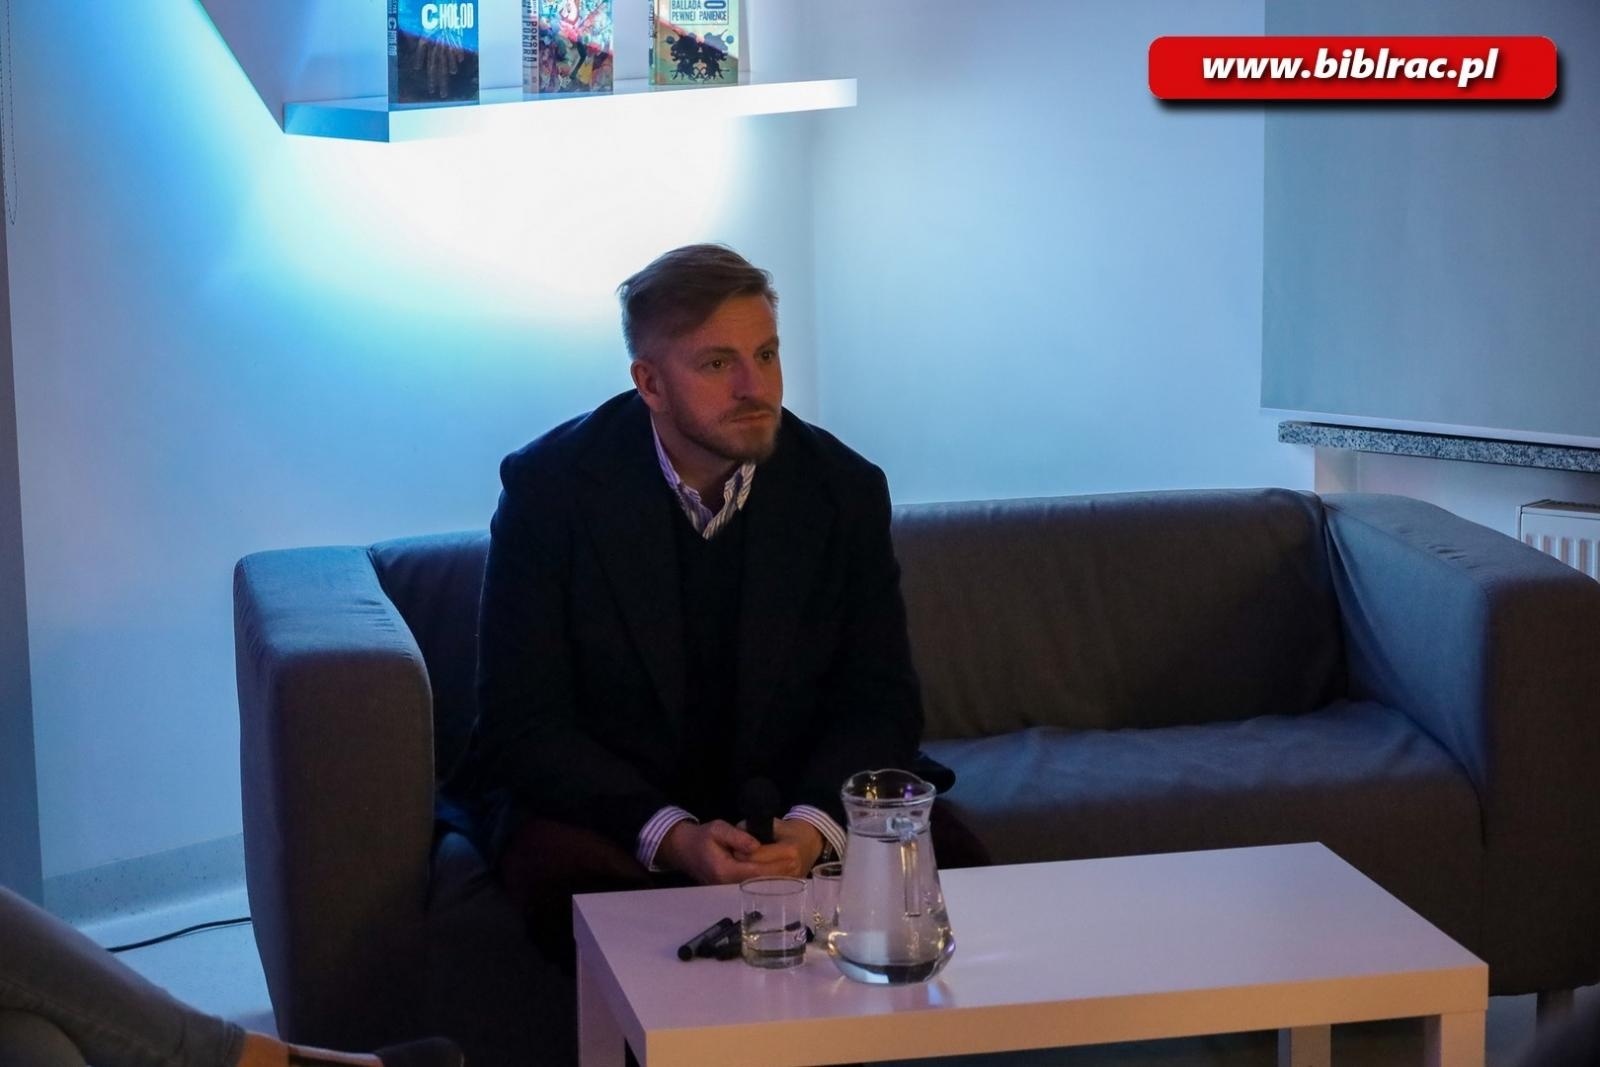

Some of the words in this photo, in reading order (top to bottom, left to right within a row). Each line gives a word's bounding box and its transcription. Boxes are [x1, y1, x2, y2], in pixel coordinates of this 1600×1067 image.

[671, 0, 702, 10] BALLADA
[671, 11, 696, 21] PEWNEJ
[699, 10, 727, 21] PANIENCE
